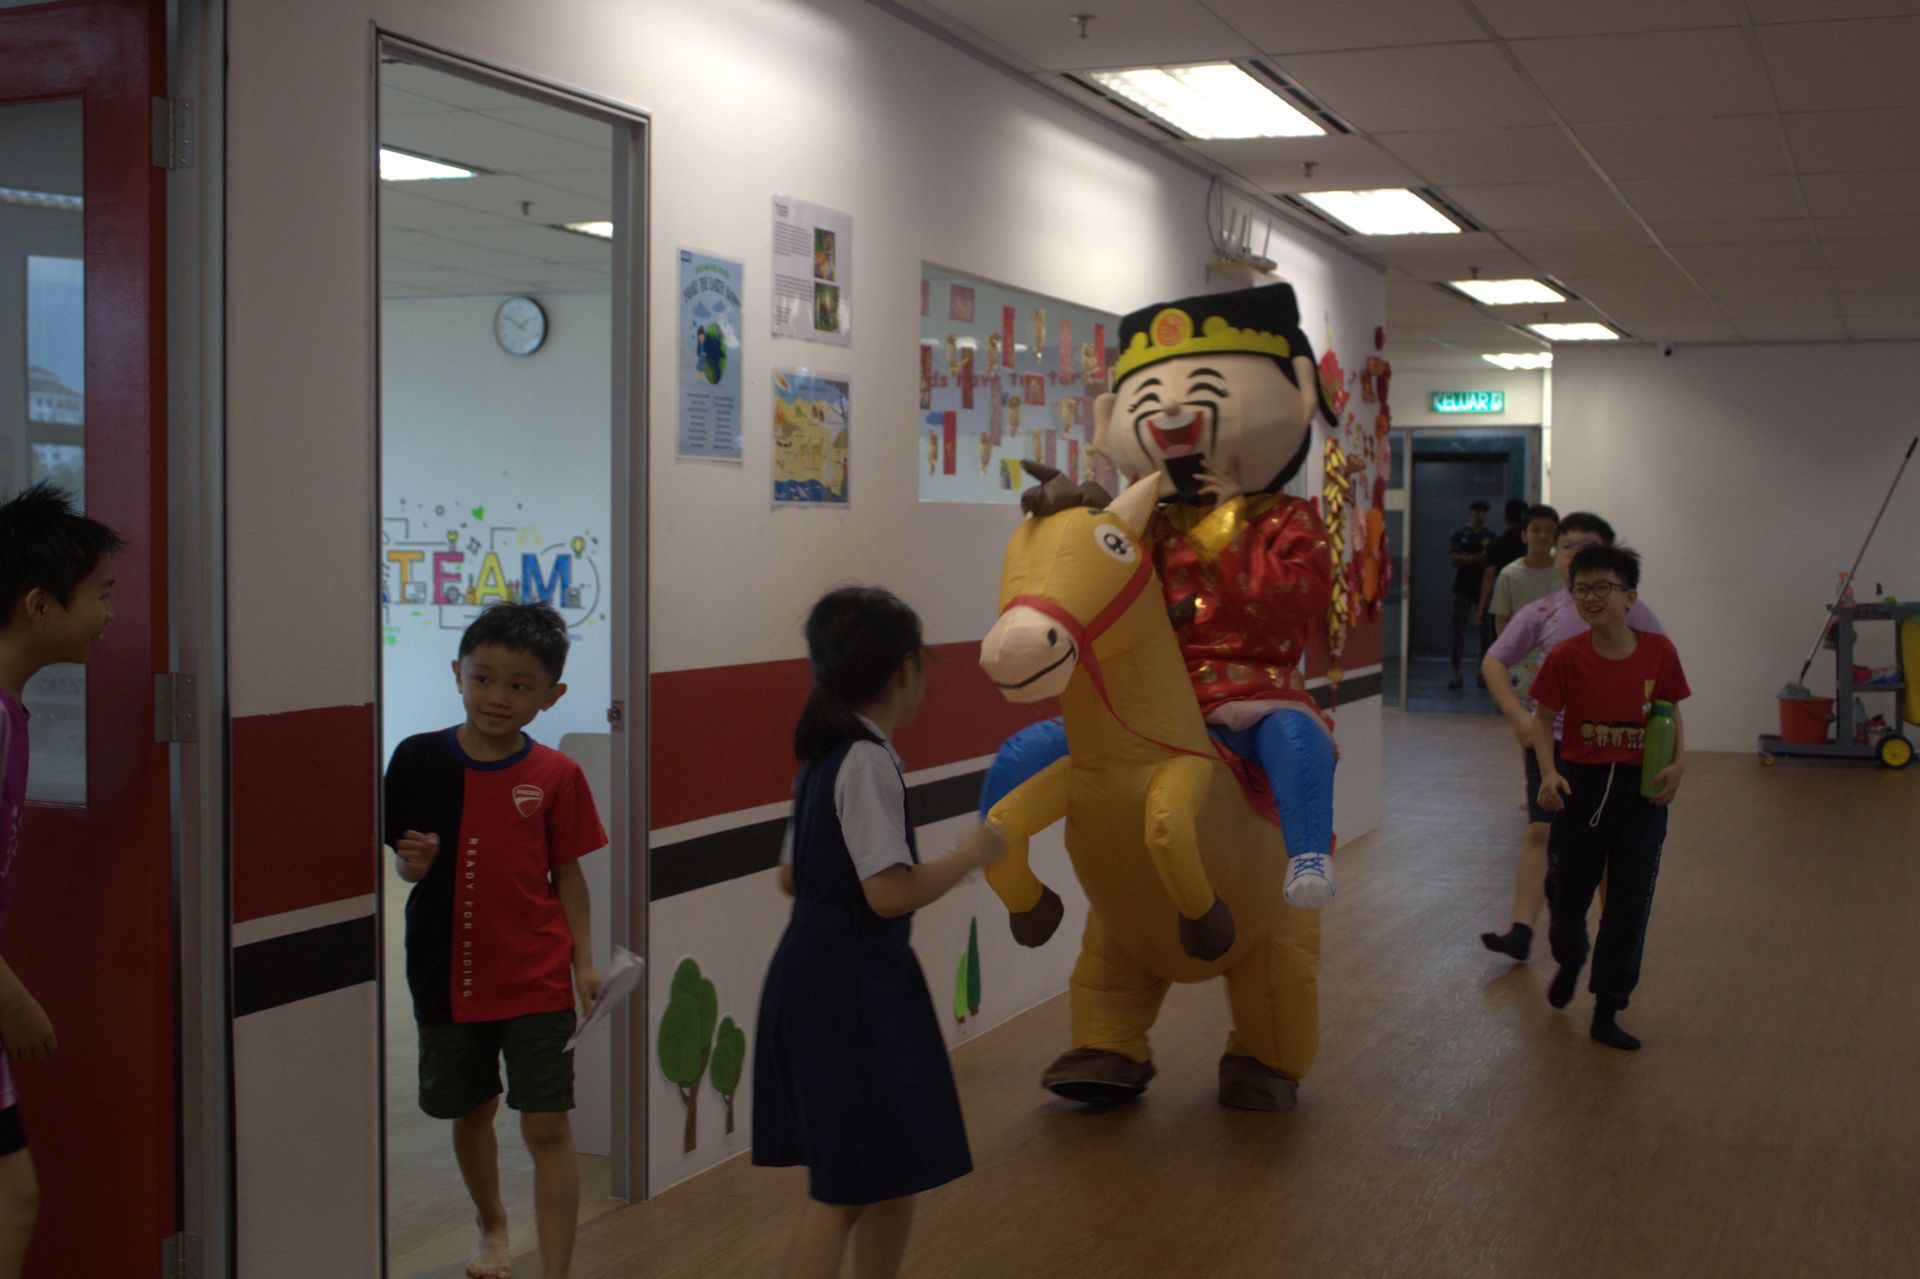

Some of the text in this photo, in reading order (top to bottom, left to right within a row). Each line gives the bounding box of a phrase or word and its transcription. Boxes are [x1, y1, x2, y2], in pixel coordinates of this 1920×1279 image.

[1433, 391, 1488, 412] KELUAR
[461, 836, 480, 999] READY FOR RIDING
